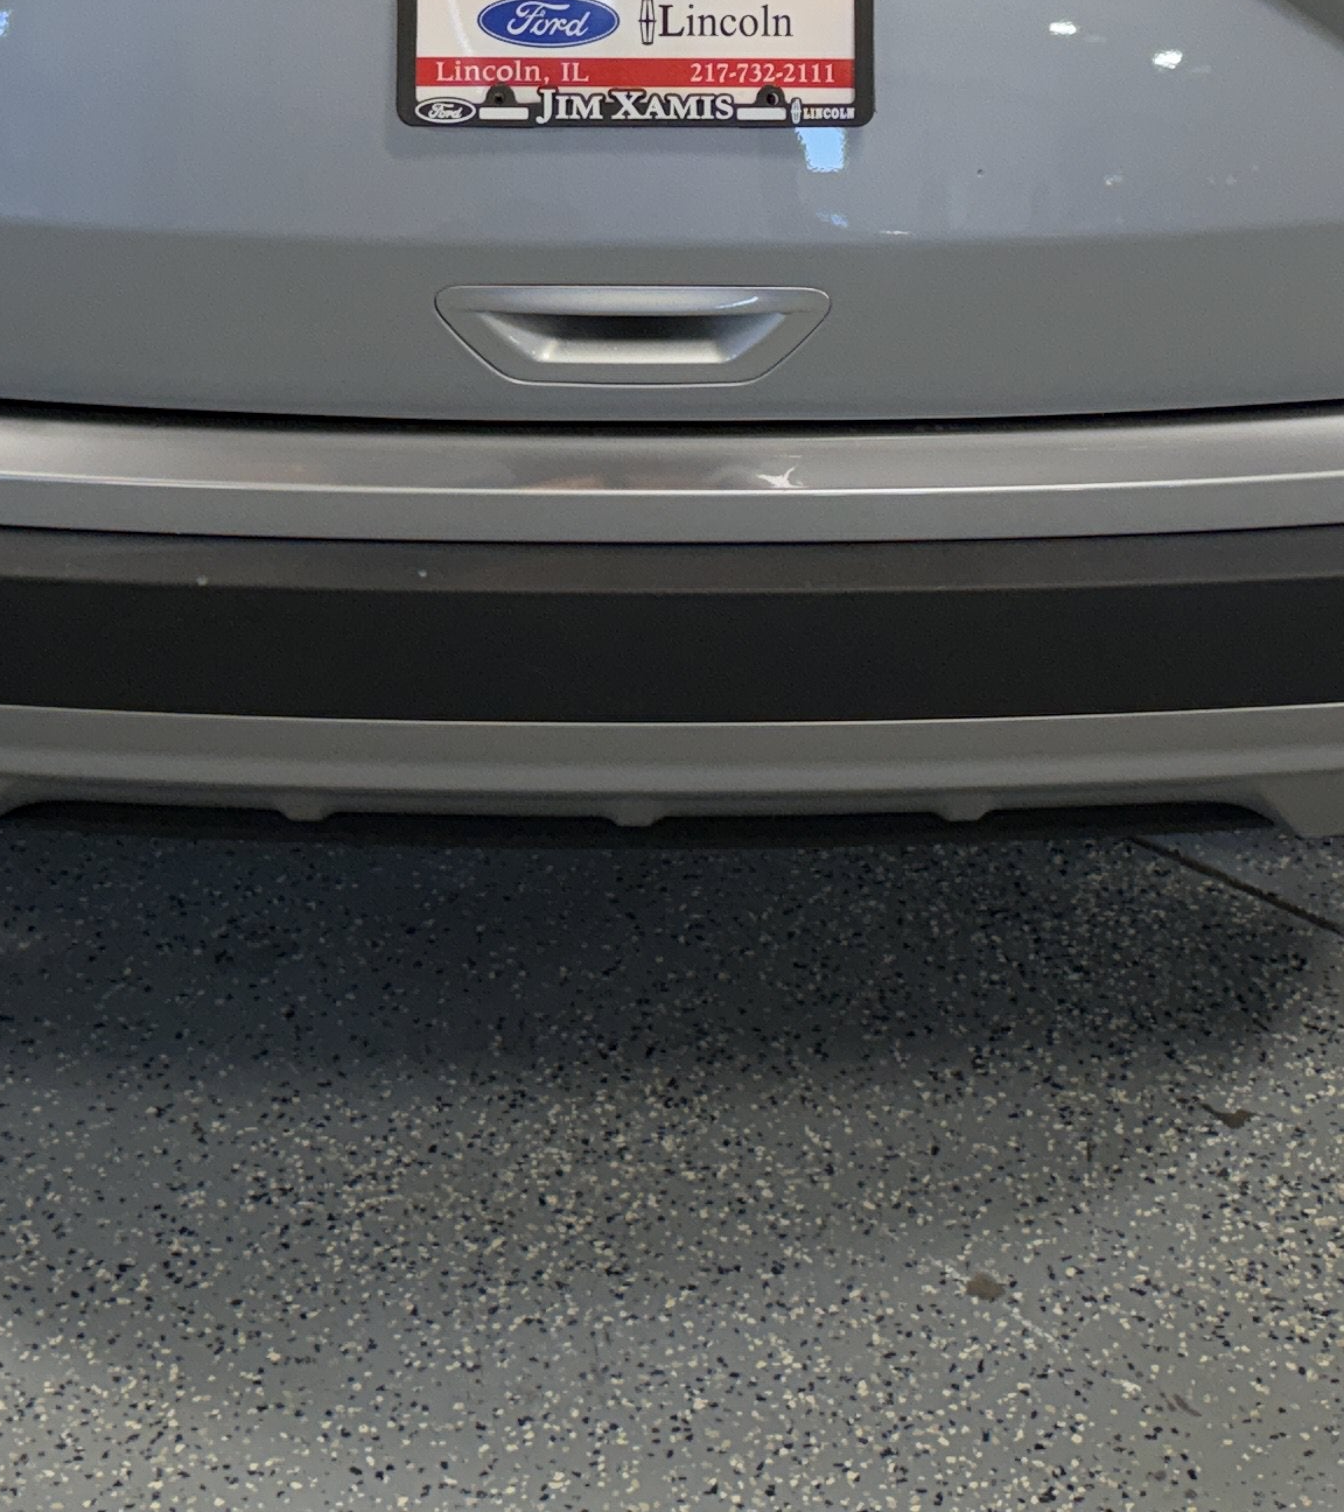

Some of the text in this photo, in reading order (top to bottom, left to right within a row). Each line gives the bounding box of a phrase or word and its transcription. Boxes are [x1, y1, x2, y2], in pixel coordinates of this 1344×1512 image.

[506, 0, 590, 39] Ford
[658, 4, 794, 38] Lincoln
[436, 61, 590, 85] Lincoln, IL
[690, 62, 836, 84] 217-732-2111
[427, 102, 474, 121] Ford
[536, 88, 735, 125] JIM XAMIS
[803, 107, 856, 120] LINCOLN
